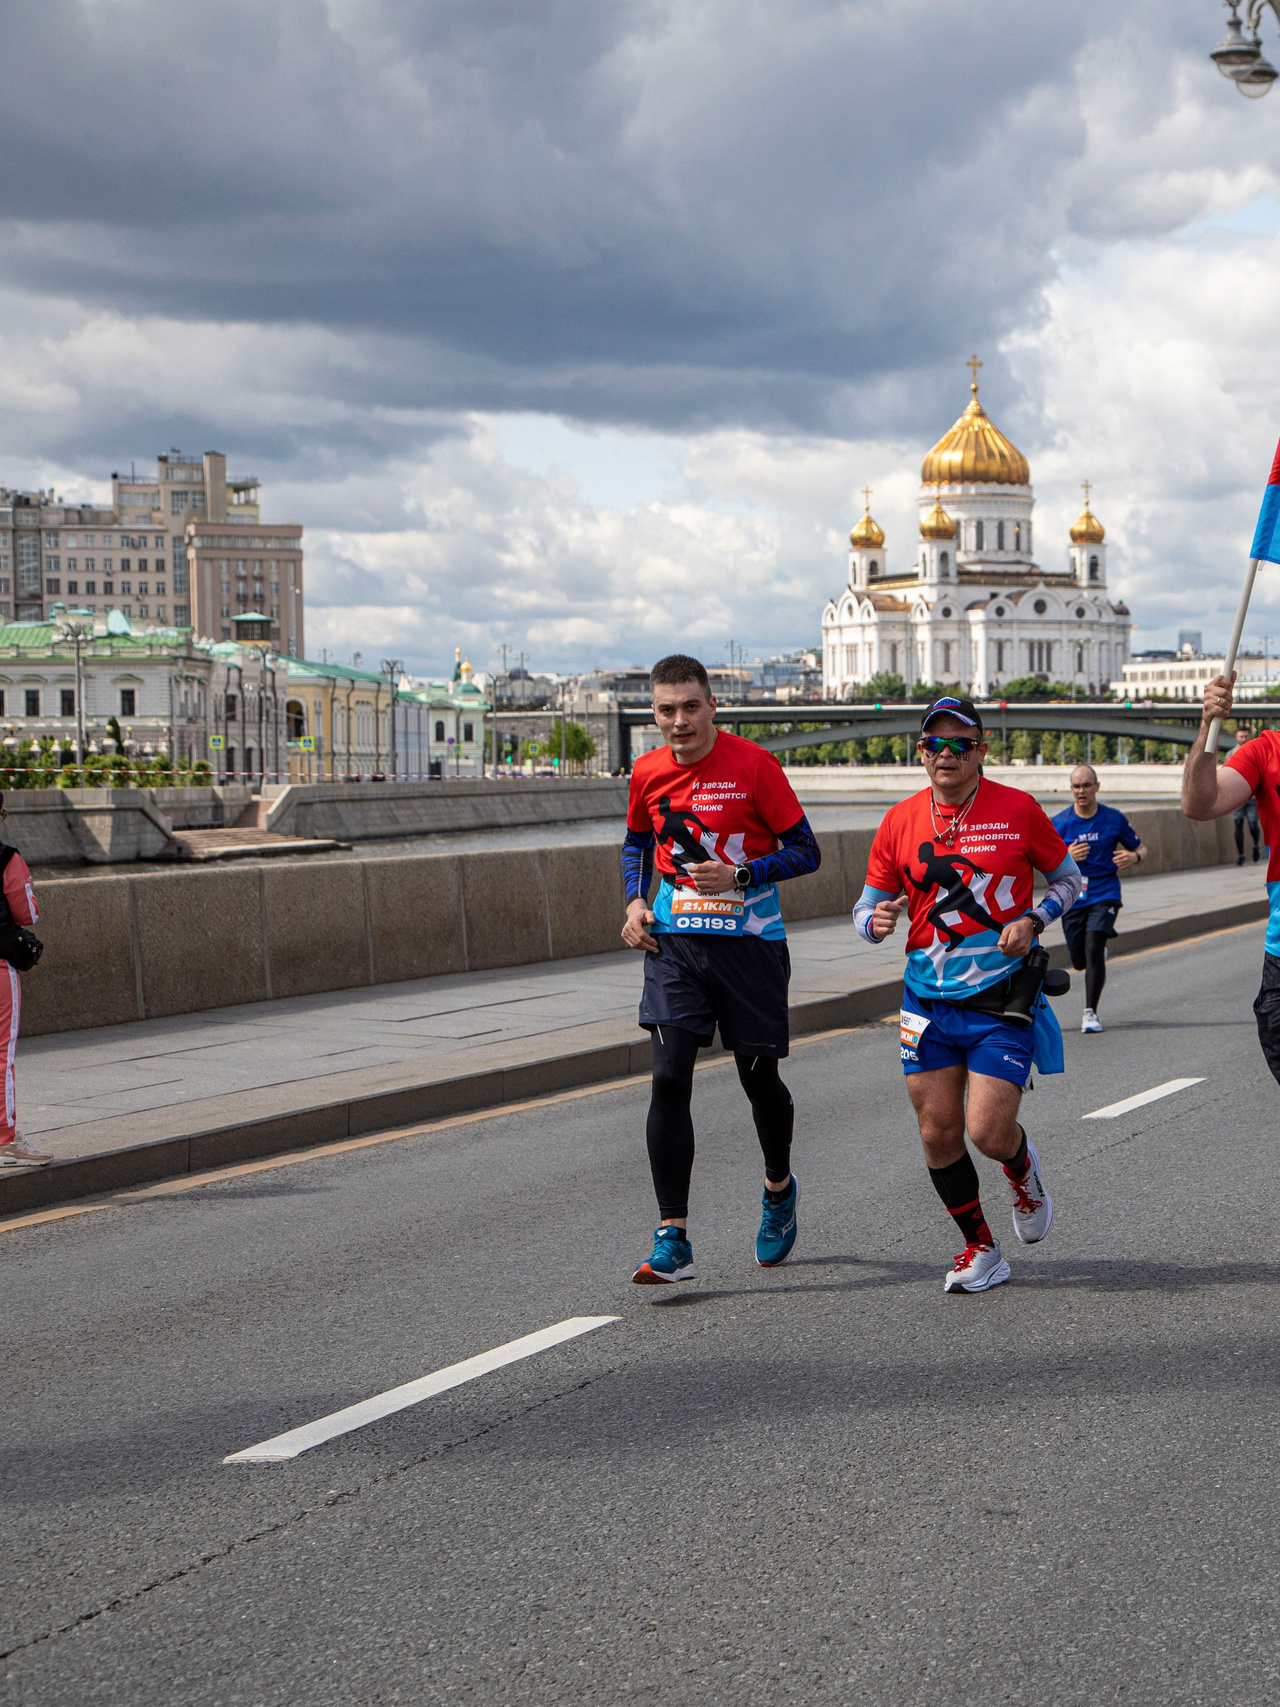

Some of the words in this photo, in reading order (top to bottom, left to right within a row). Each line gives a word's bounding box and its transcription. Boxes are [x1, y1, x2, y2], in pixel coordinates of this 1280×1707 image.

[692, 782, 700, 790] И
[702, 781, 737, 790] звезды
[692, 792, 747, 801] становятся
[691, 803, 723, 812] ближе
[959, 823, 967, 832] И
[969, 822, 1009, 832] звезды
[960, 833, 1021, 843] становятся
[960, 844, 997, 854] ближе
[676, 916, 737, 931] 03193
